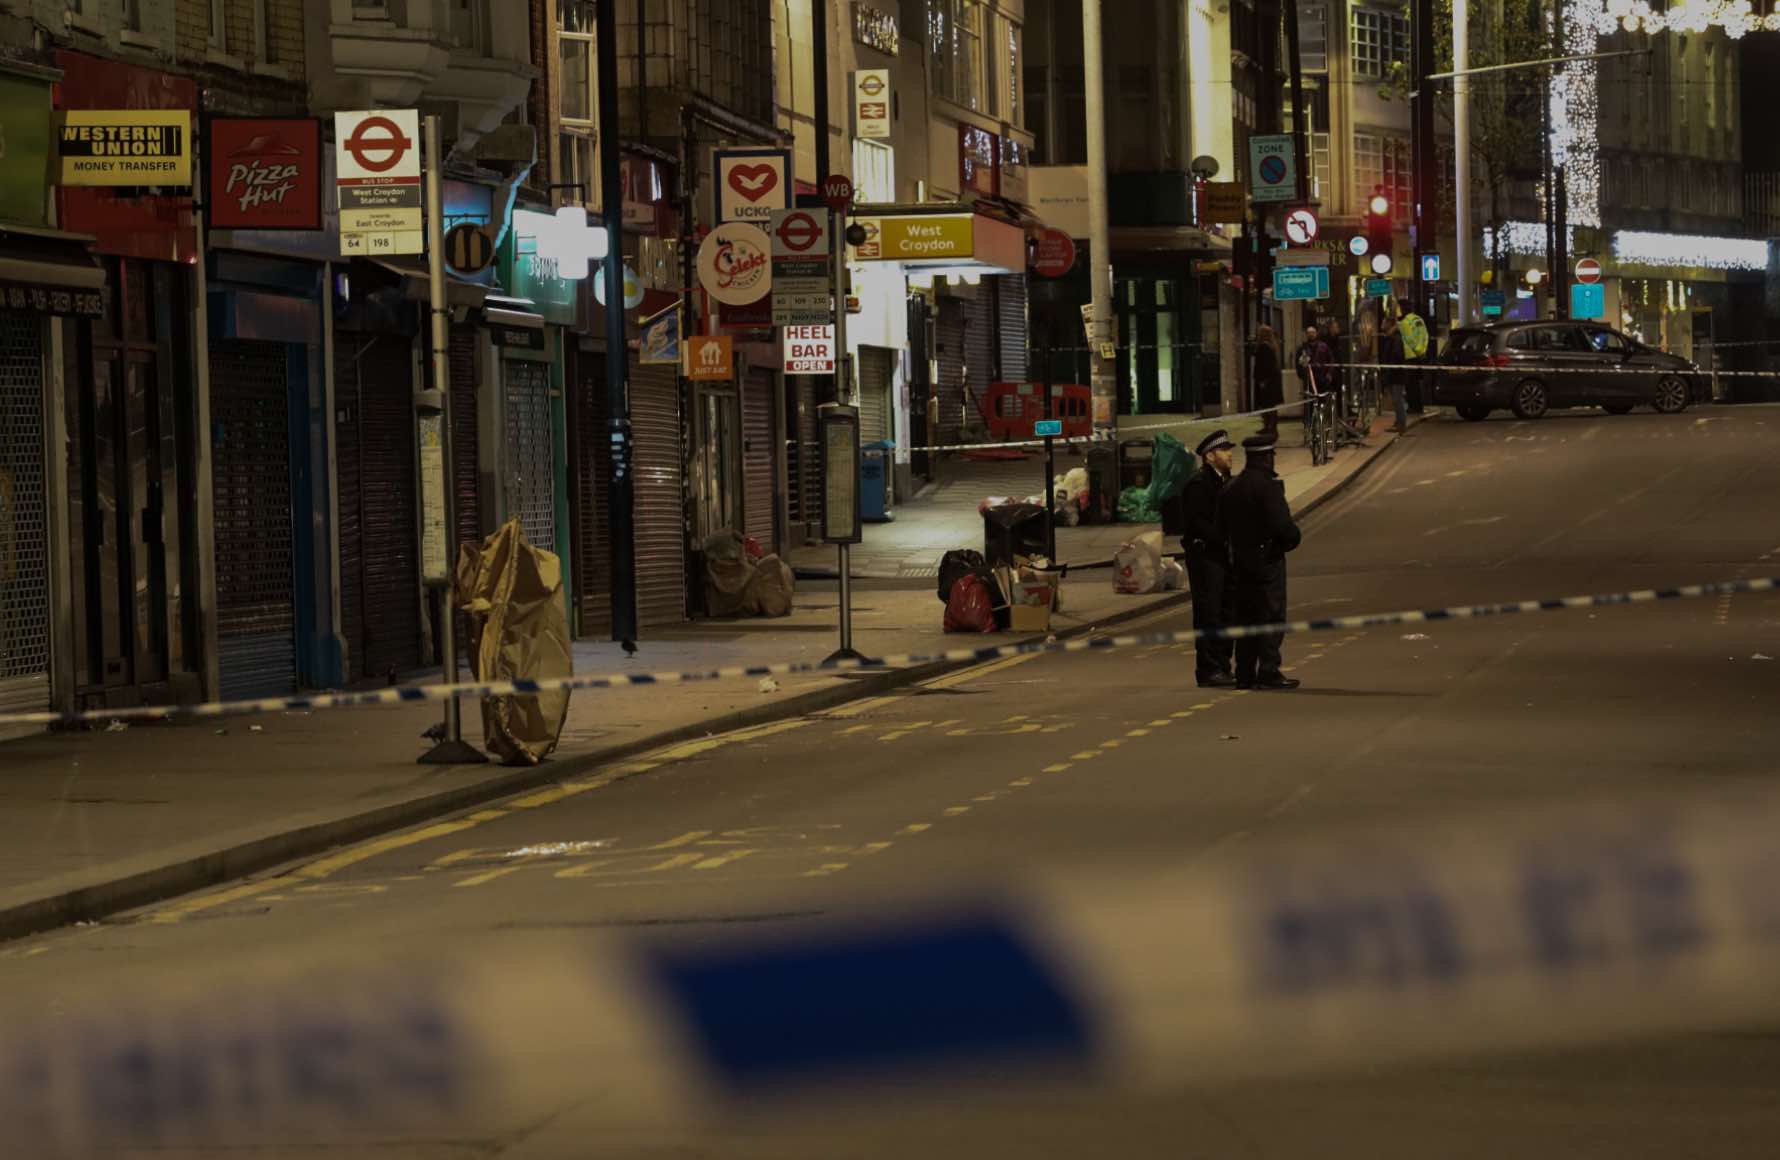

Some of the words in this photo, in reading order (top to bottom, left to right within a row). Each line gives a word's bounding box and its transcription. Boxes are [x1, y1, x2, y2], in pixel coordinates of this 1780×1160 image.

[63, 127, 160, 141] WESTERN
[91, 141, 160, 155] UNION
[1258, 144, 1285, 154] ZONE
[74, 161, 115, 171] MONEY
[119, 161, 176, 171] TRANSFER
[226, 160, 299, 193] Pizza
[352, 189, 372, 197] West
[373, 188, 406, 197] Croydon
[825, 183, 849, 197] WB
[239, 181, 296, 212] Hut
[360, 197, 388, 205] Station
[374, 219, 406, 228] Croydon
[907, 224, 942, 237] West
[347, 240, 360, 248] 64
[373, 239, 389, 247] 198
[900, 239, 954, 251] Croydon
[786, 326, 831, 340] HEEL
[792, 345, 827, 358] BAR
[793, 361, 827, 371] OPEN
